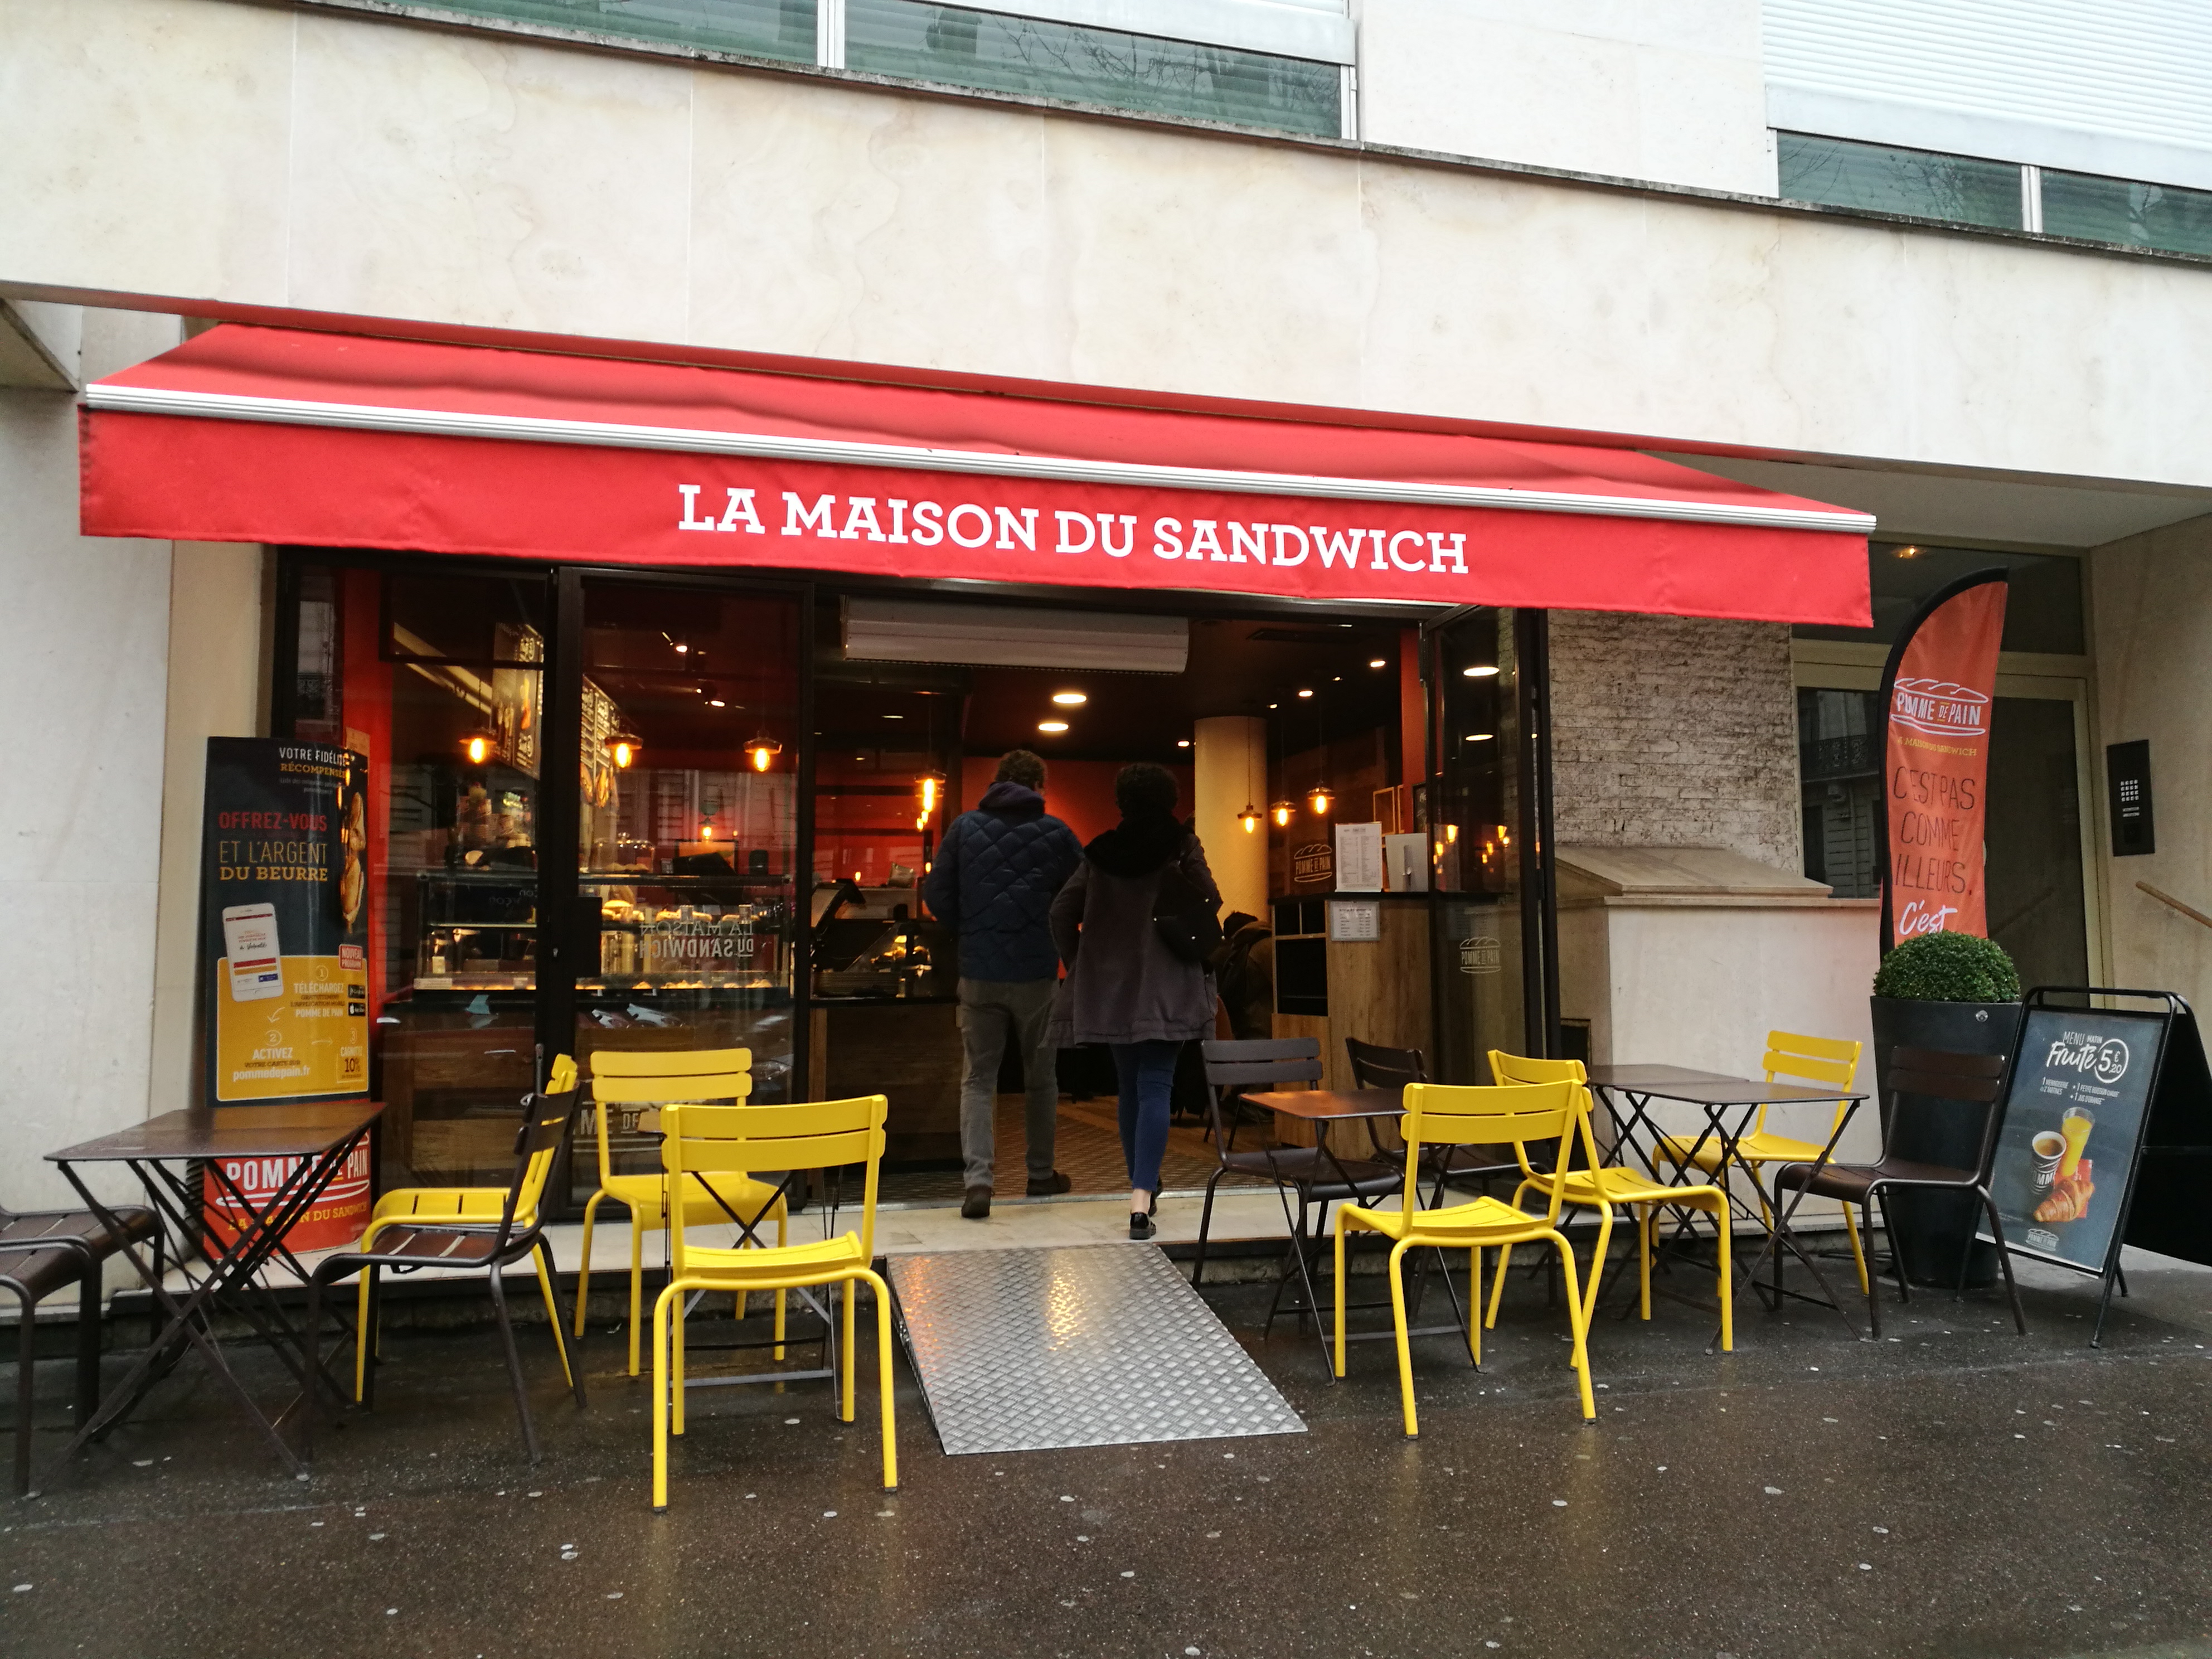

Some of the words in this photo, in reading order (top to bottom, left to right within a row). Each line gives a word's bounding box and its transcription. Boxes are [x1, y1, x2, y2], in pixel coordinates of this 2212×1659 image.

[678, 484, 765, 535] LA
[781, 491, 1039, 551] MAISON
[1054, 510, 1137, 558] DU
[1153, 517, 1469, 574] SANDWICH
[1938, 706, 1949, 719] DE
[1948, 703, 1981, 725] PAIN
[279, 747, 313, 761] VOTRE
[1937, 744, 1977, 756] SANDWICH
[1939, 775, 1976, 809] PAS
[218, 812, 328, 831] OFFREZ-VOUS
[1900, 811, 1960, 851] COMME
[220, 841, 240, 863] ET
[249, 841, 328, 864] L'ARGENT
[1296, 859, 1313, 875] POMME
[1320, 856, 1331, 871] PAIN
[220, 867, 250, 880] DU
[256, 867, 328, 881] BEURRE
[1898, 899, 1958, 936] C'est
[1461, 950, 1481, 965] POMME
[1487, 949, 1500, 964] PAIN
[293, 981, 344, 994] TÉLÉCHARGEZ
[295, 1008, 321, 1017] POMME
[2063, 1031, 2085, 1046] MENU
[2087, 1035, 2103, 1044] MATIN
[252, 1047, 293, 1060] ACTIVEZ
[233, 1065, 310, 1081] pommedepain.fr
[345, 1058, 361, 1073] 10%
[347, 1148, 368, 1179] PAIN
[313, 1208, 331, 1223] DU
